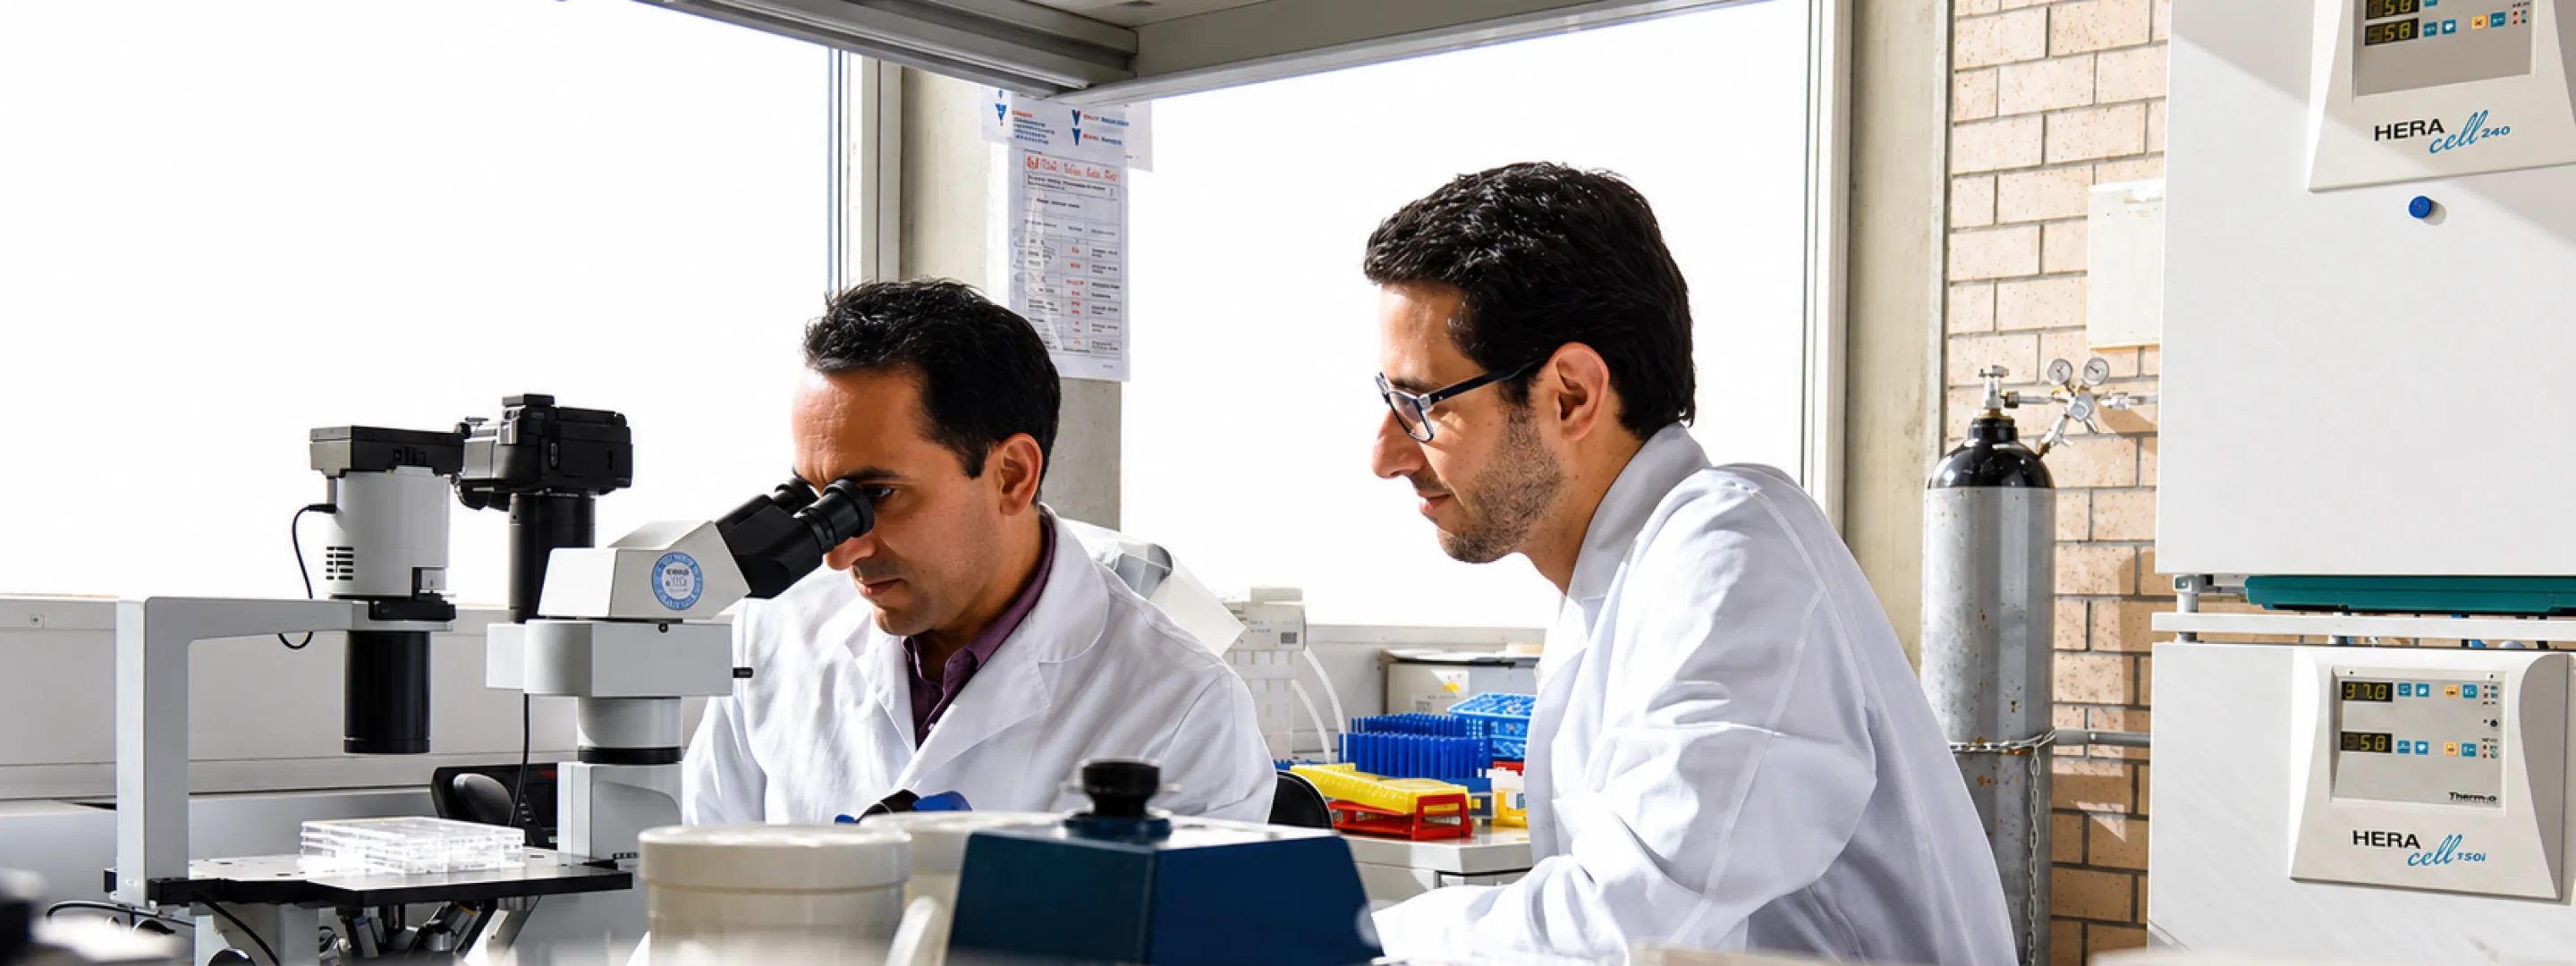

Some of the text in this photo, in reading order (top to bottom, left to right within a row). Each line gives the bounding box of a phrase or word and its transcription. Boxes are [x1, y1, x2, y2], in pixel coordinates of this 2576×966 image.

[2375, 109, 2511, 154] HERA cell 240
[2352, 829, 2421, 850] HERA
[2407, 834, 2463, 867] cell
